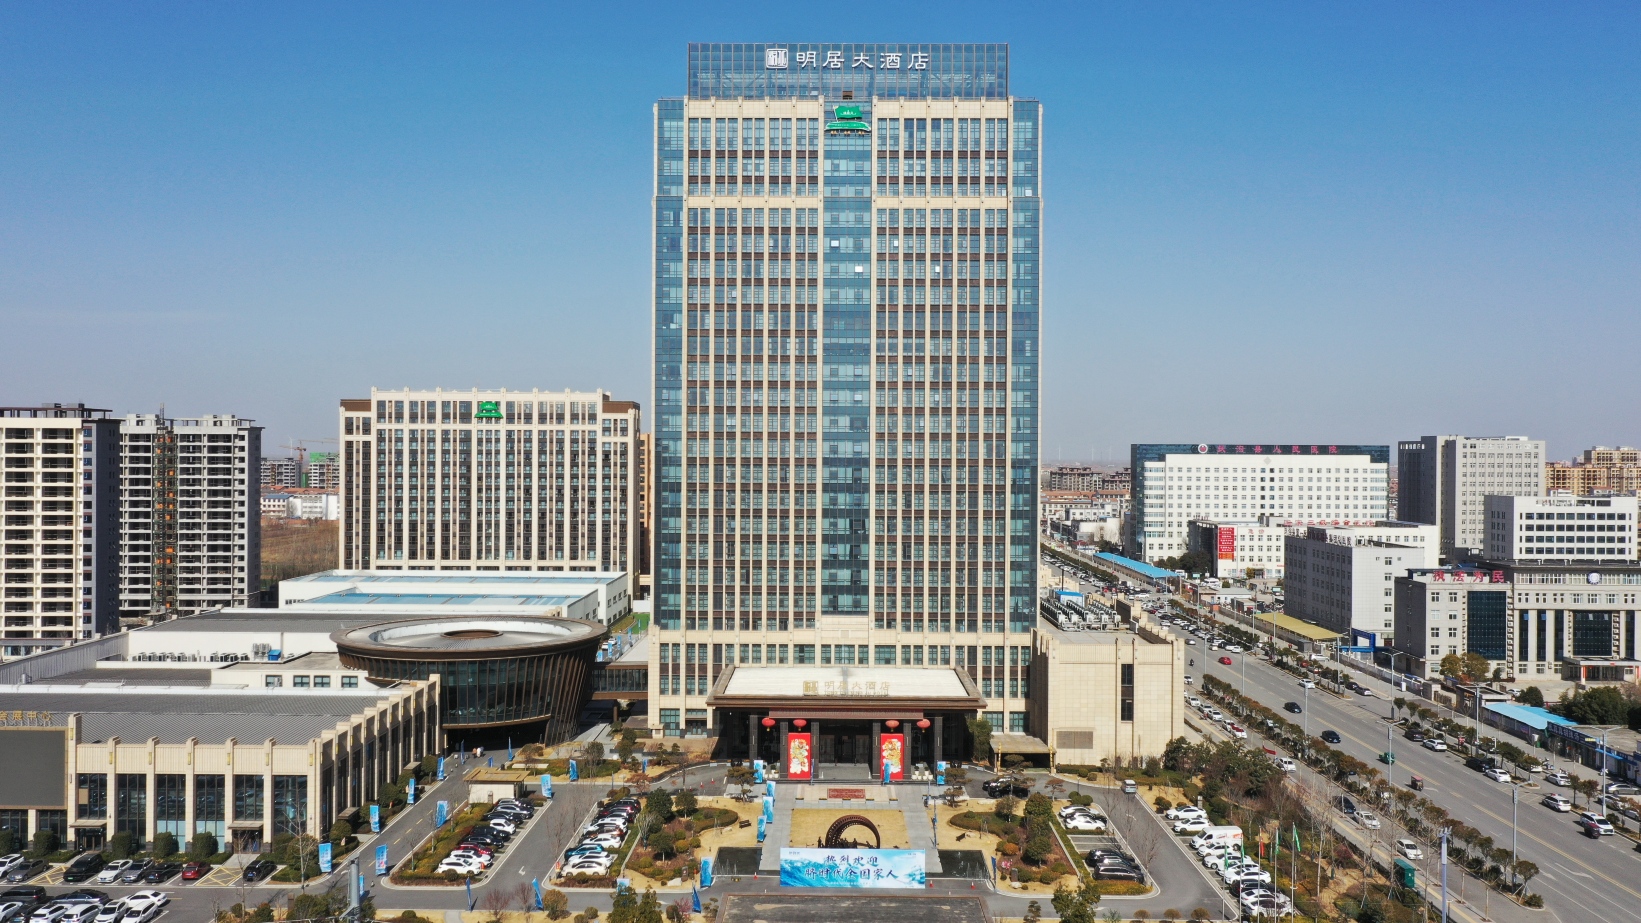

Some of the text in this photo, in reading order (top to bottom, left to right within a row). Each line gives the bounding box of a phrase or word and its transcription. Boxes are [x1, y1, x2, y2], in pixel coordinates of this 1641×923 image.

[796, 51, 929, 70] 明居大酒店
[1433, 570, 1505, 583] 执法为民
[824, 681, 890, 690] 明居大酒店
[825, 855, 880, 867] 热烈欢迎
